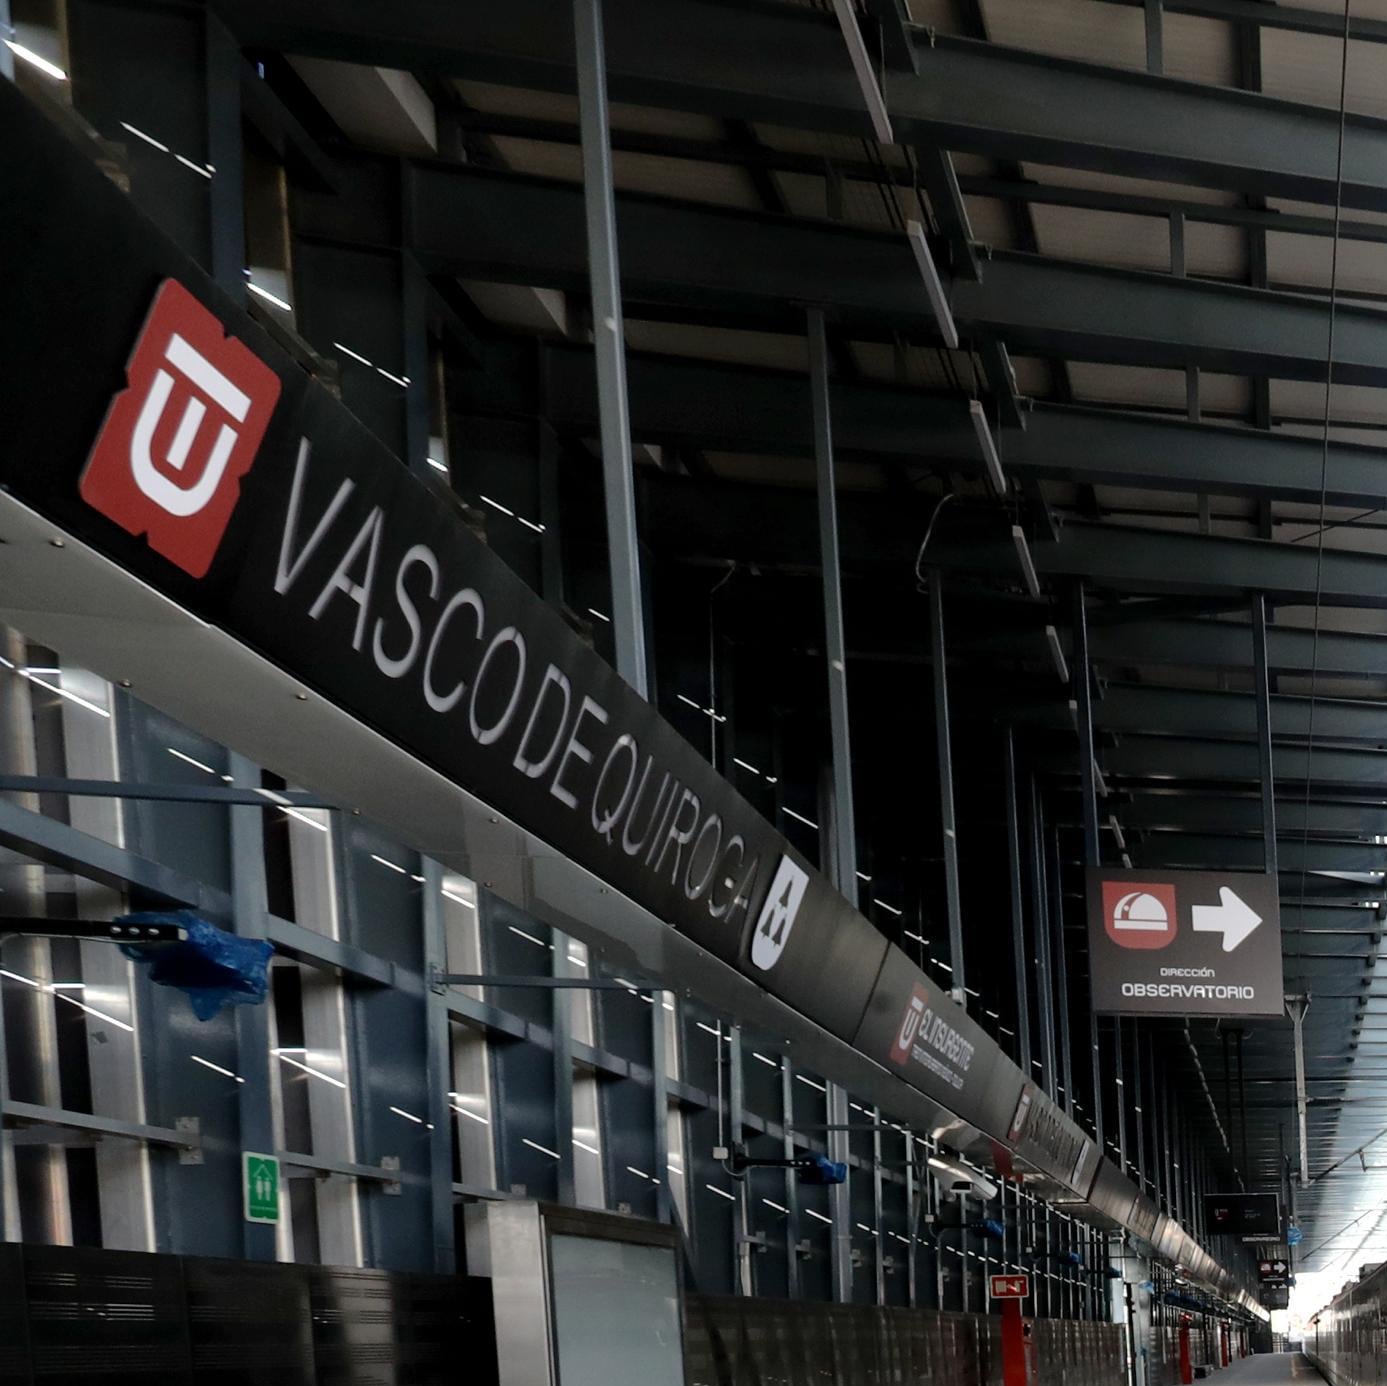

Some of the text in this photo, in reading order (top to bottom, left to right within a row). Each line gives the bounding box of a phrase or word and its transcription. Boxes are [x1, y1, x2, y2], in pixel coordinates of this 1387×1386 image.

[274, 436, 758, 945] VASCO DE QUIROGA
[1121, 983, 1254, 999] OBSERVATORIO
